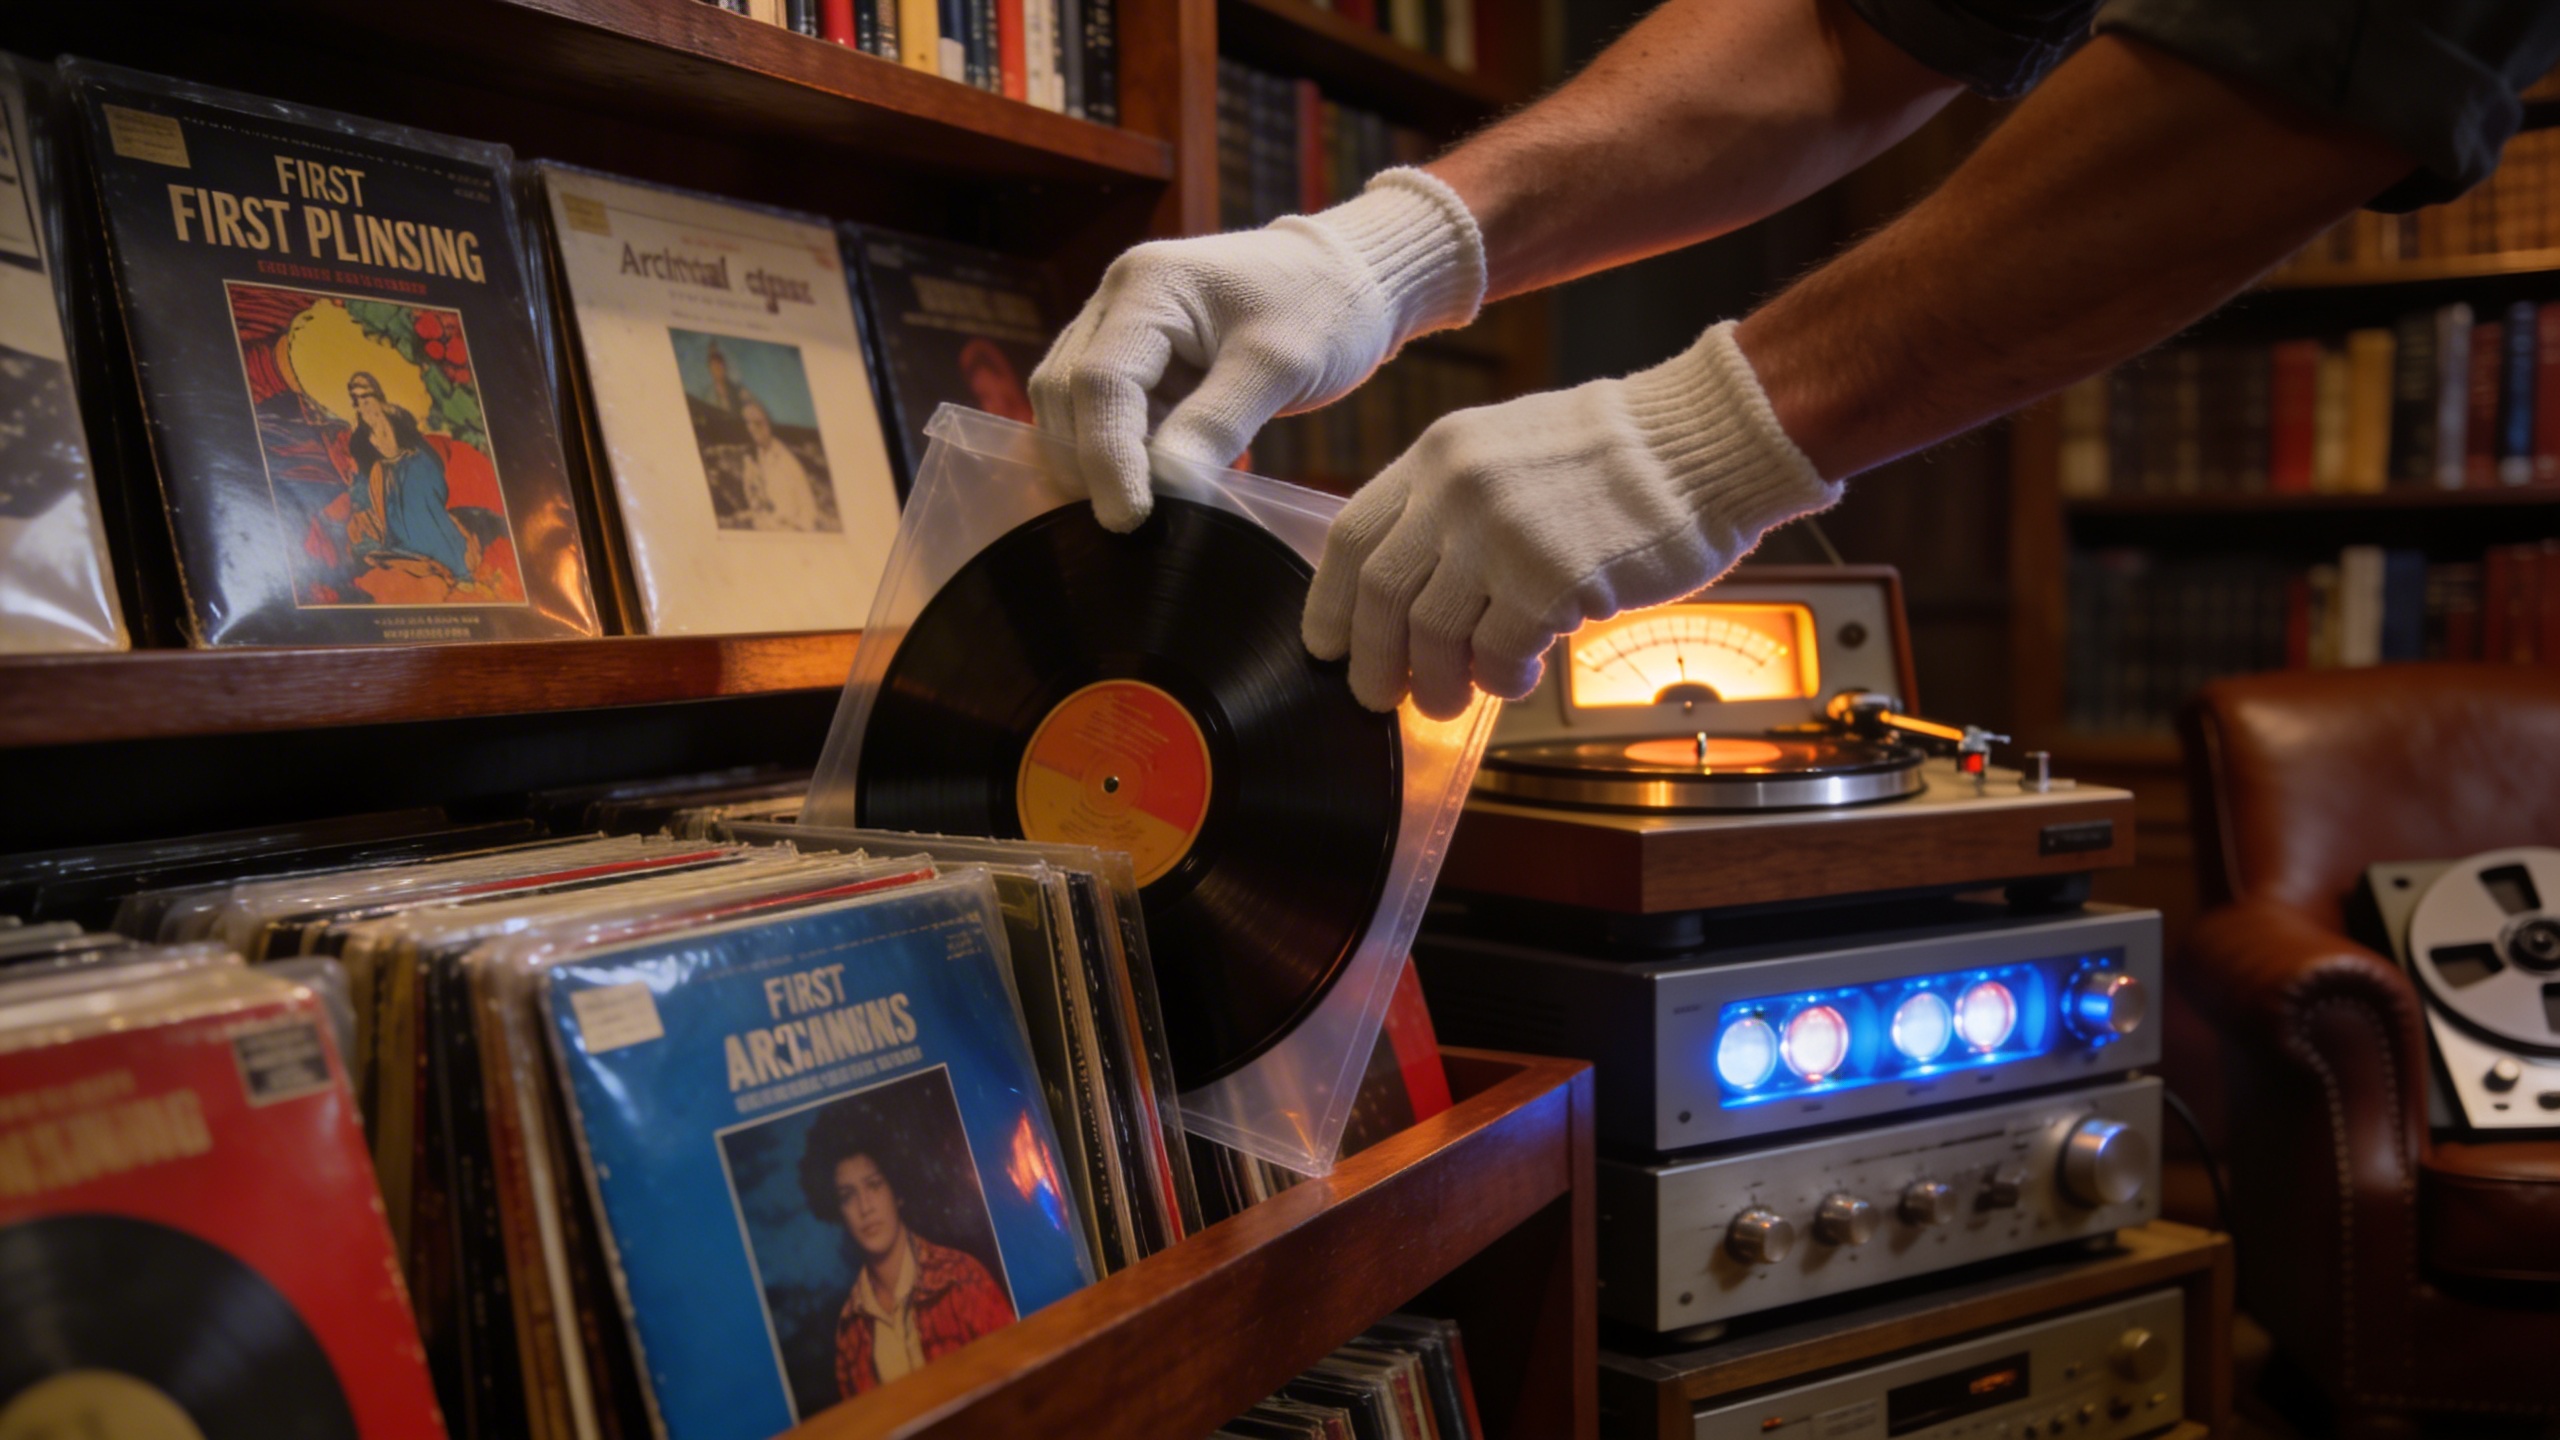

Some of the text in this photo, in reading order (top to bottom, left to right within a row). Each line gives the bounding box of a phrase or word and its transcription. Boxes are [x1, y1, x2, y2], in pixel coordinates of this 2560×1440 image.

[274, 154, 366, 209] FIRST
[167, 183, 291, 255] FIRST
[302, 203, 487, 285] PLINSING
[763, 962, 846, 1021] FIRST
